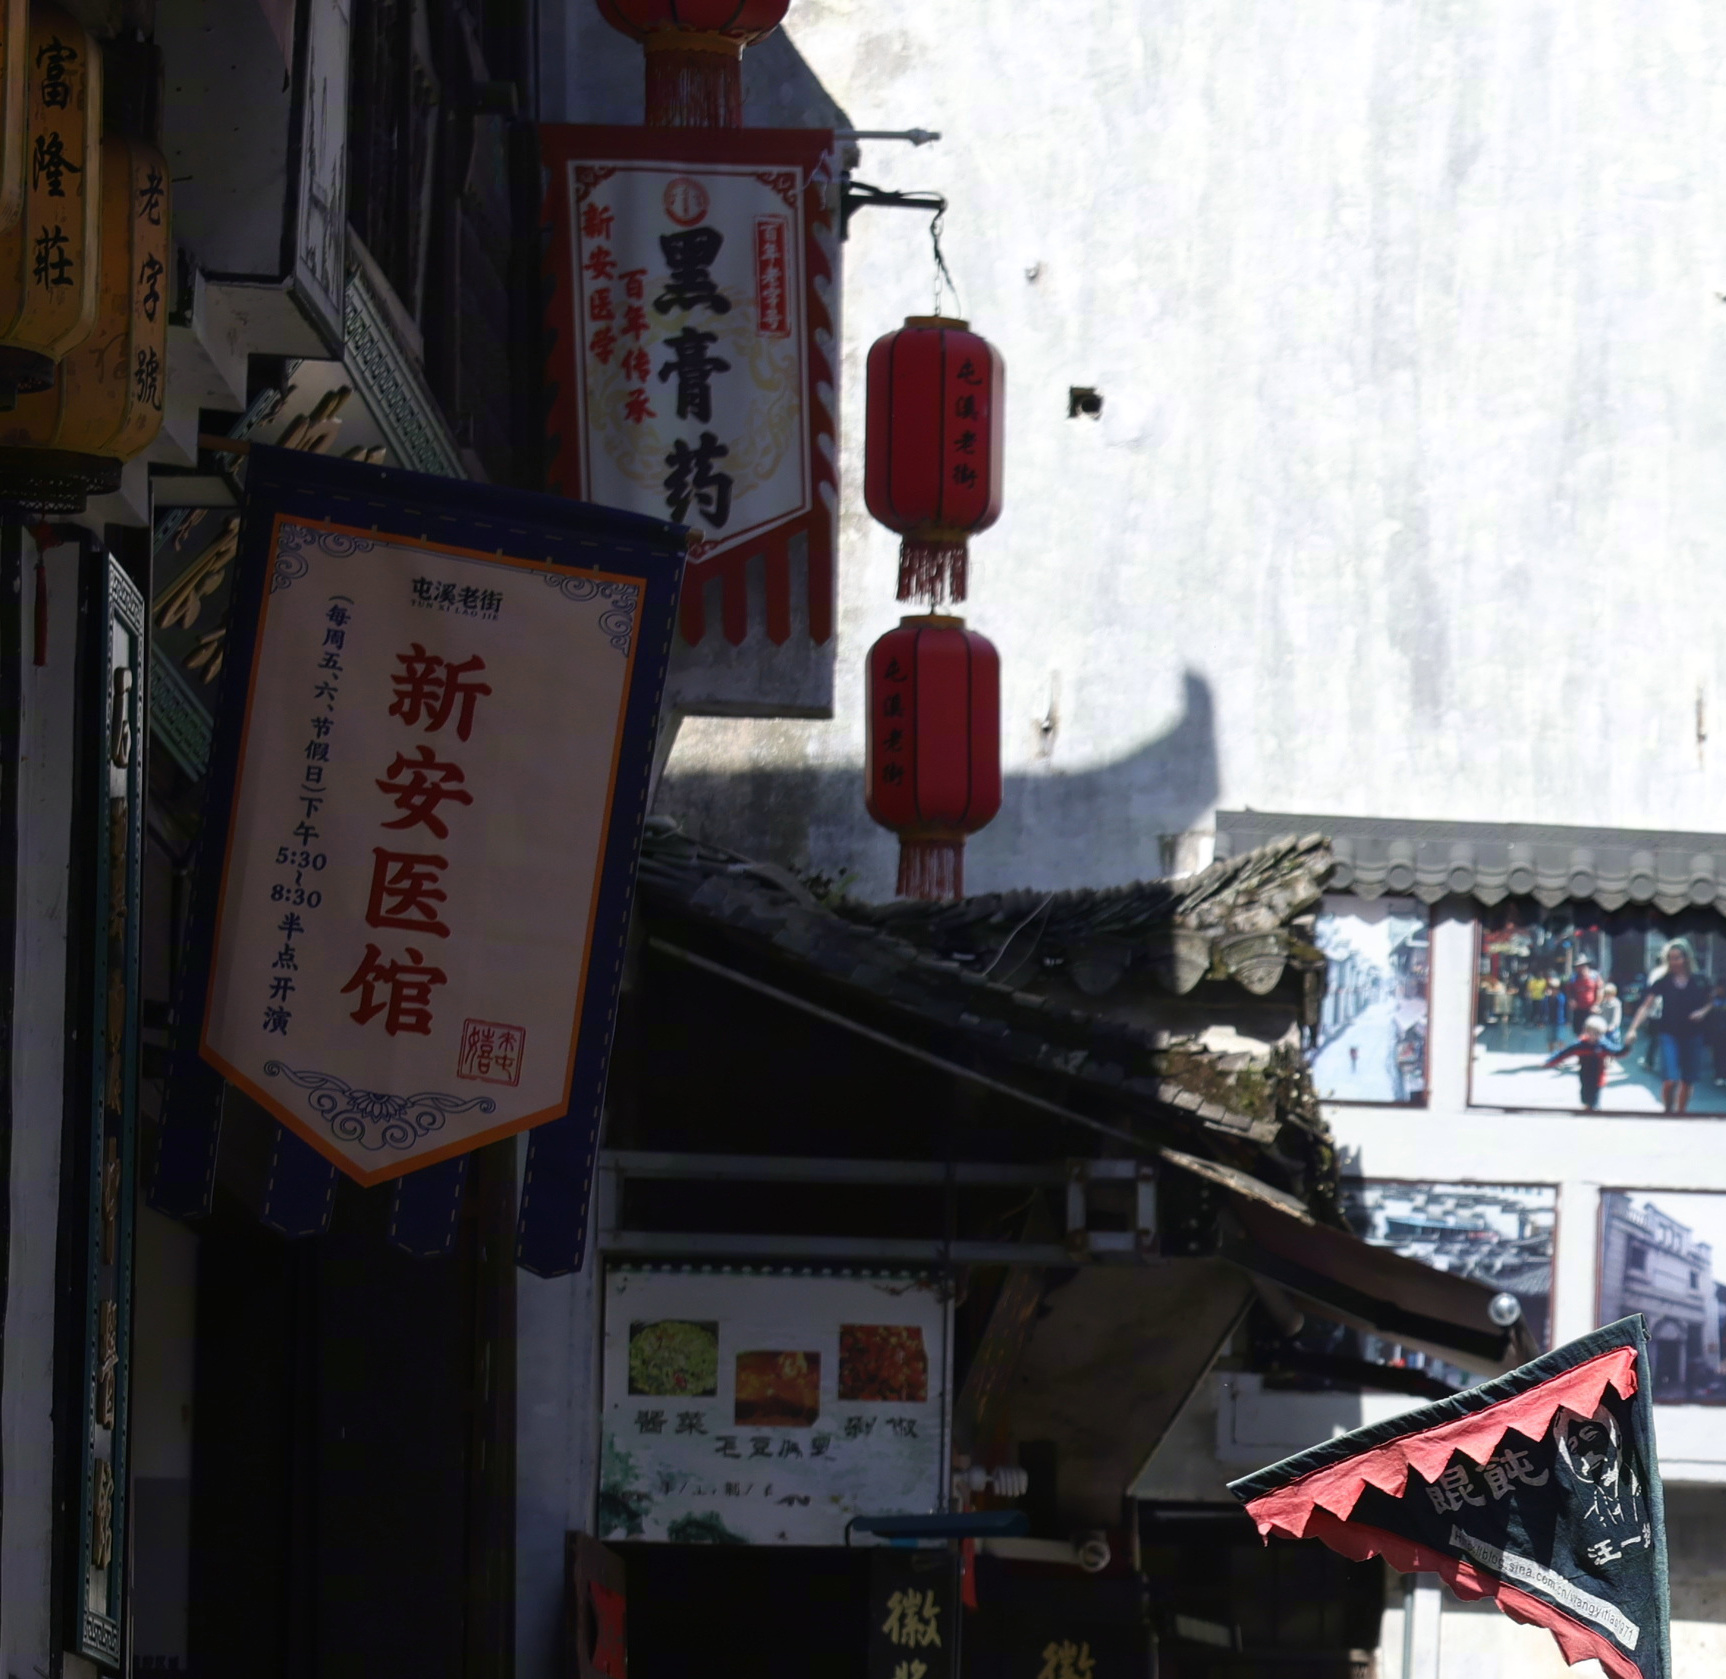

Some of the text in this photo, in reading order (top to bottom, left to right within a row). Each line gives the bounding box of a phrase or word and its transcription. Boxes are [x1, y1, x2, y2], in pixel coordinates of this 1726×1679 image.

[134, 164, 166, 411] 老字號
[582, 202, 616, 364] 新安医学
[618, 268, 657, 424] 百年传承
[757, 221, 789, 332] 百年老字号
[654, 226, 733, 528] 黑膏药
[954, 357, 984, 491] 屯溪老街
[412, 576, 504, 613] 屯溪老街
[340, 643, 492, 1037] 新安医馆
